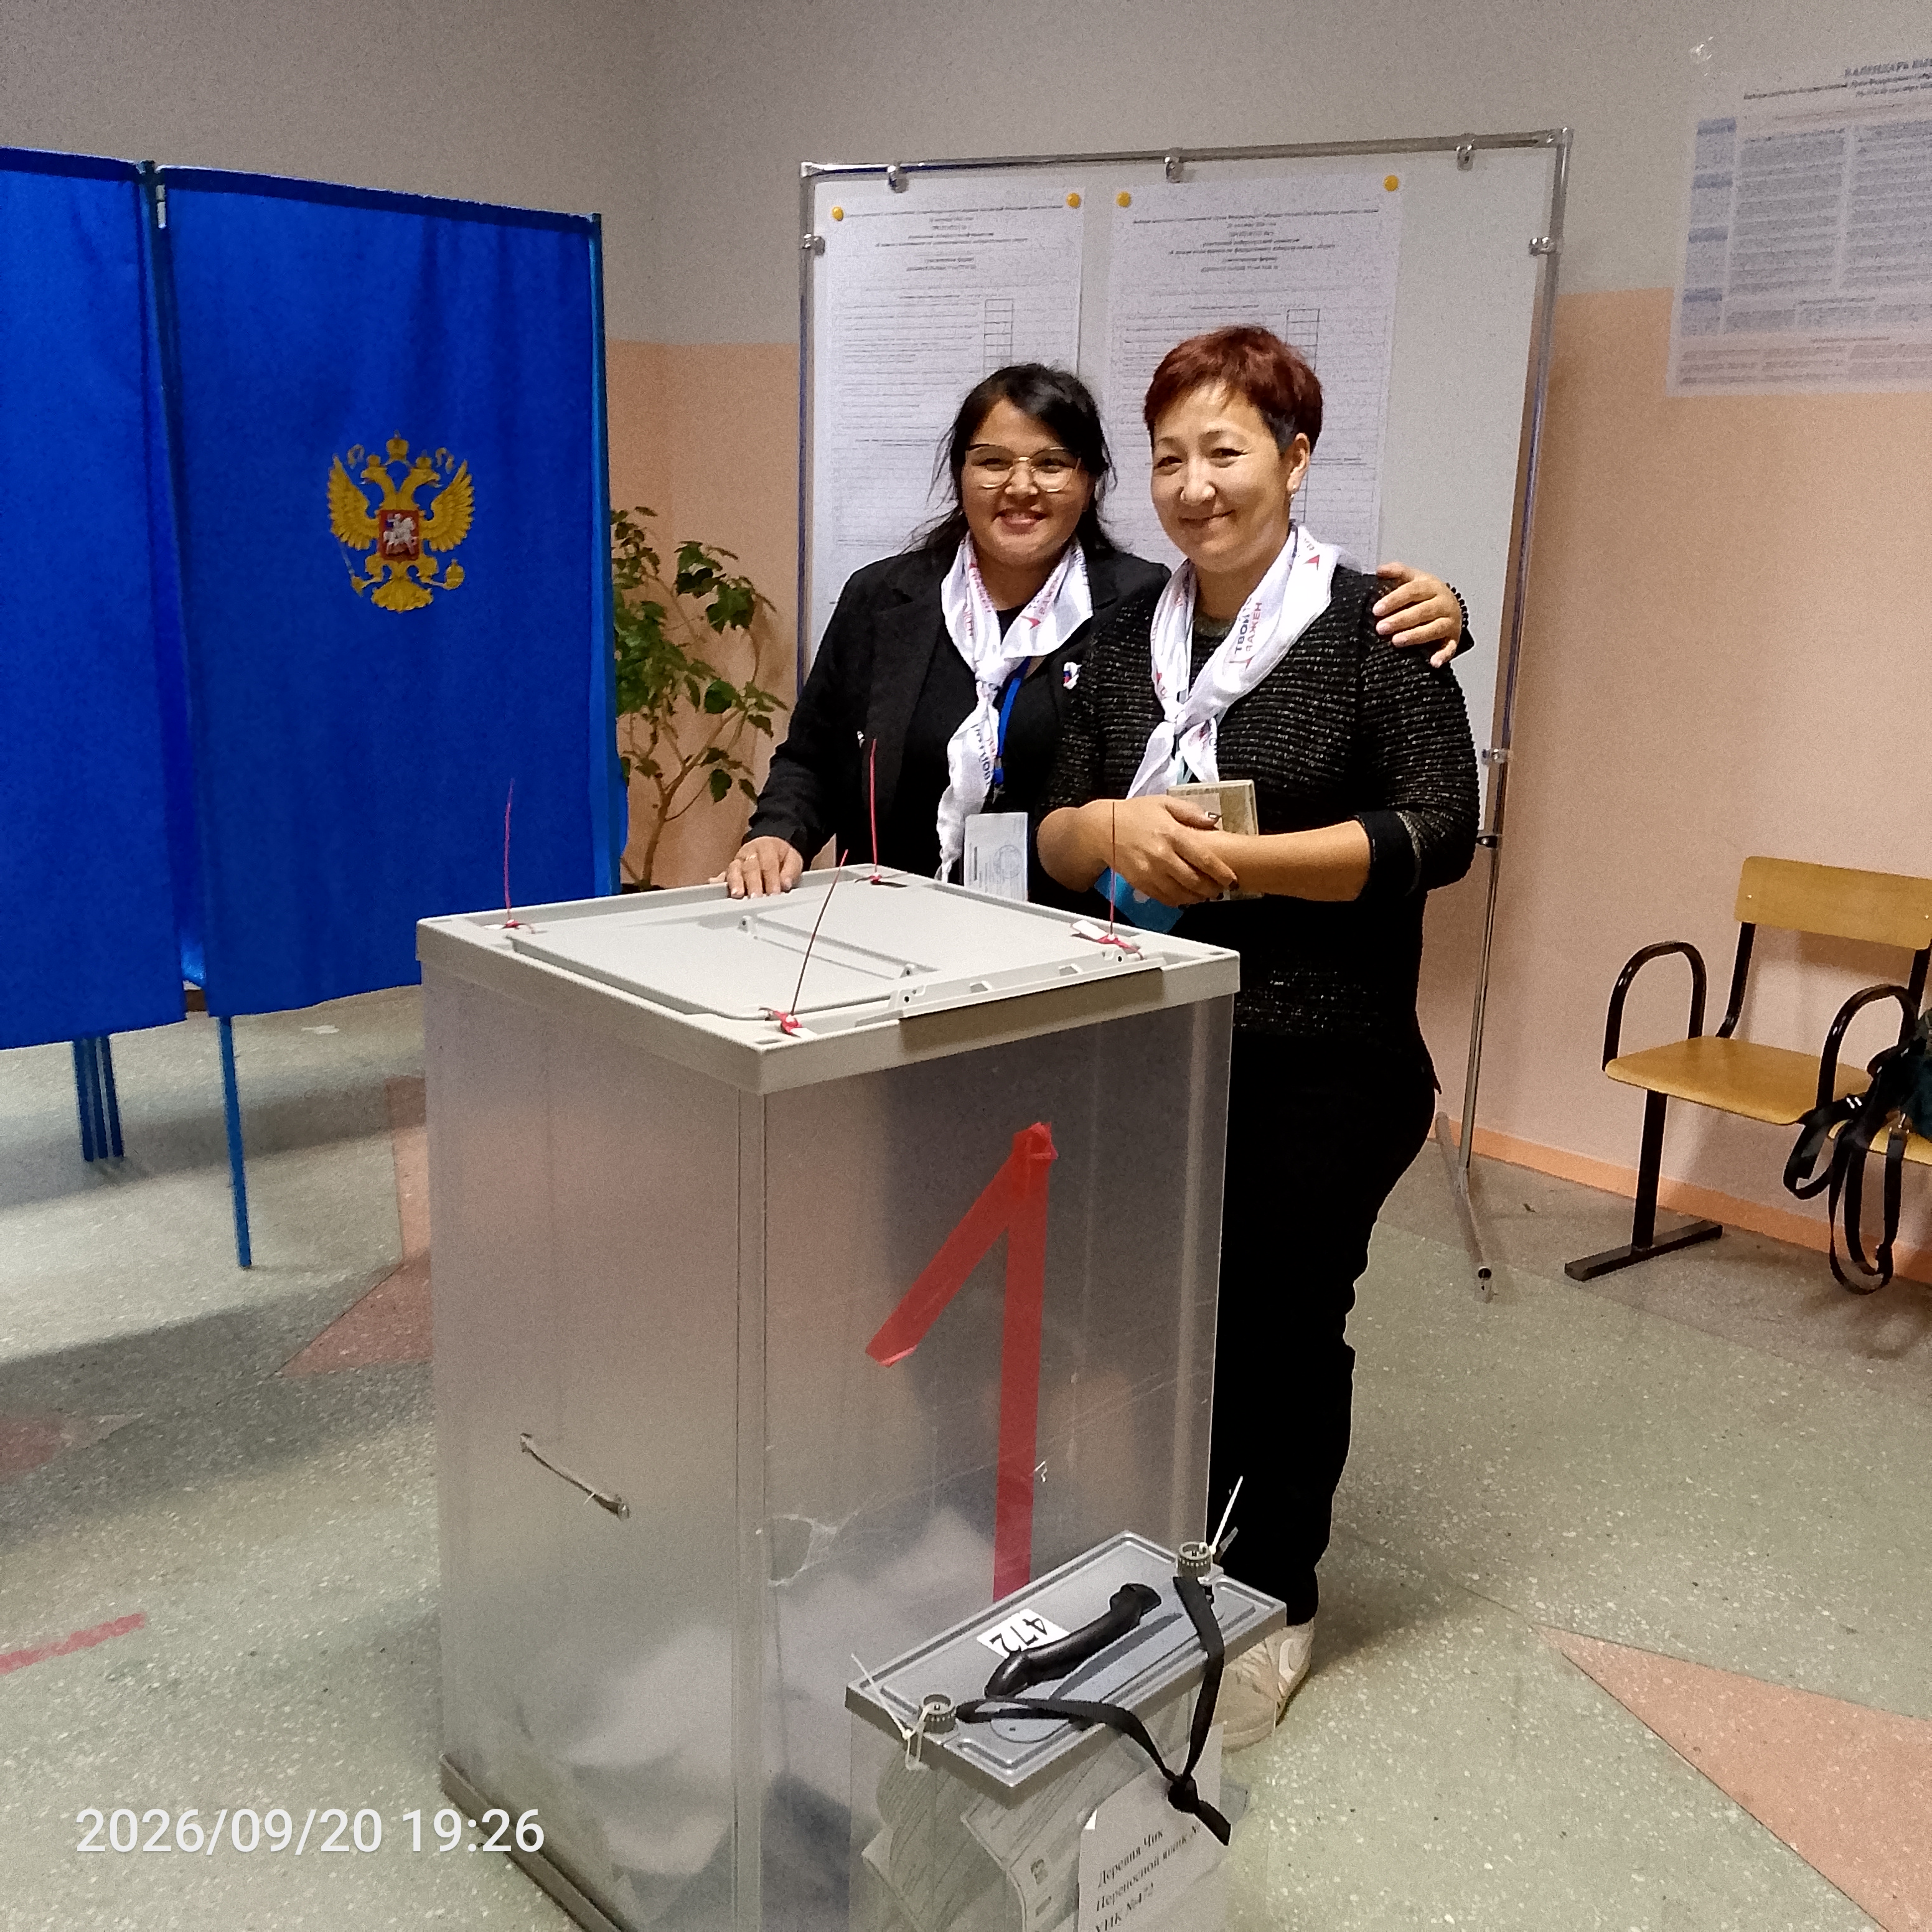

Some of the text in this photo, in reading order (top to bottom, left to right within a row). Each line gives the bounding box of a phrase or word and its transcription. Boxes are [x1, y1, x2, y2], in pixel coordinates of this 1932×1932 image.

[866, 1122, 1057, 1604] 1
[989, 1618, 1048, 1653] 472
[1098, 1829, 1163, 1889] Деревня Чик
